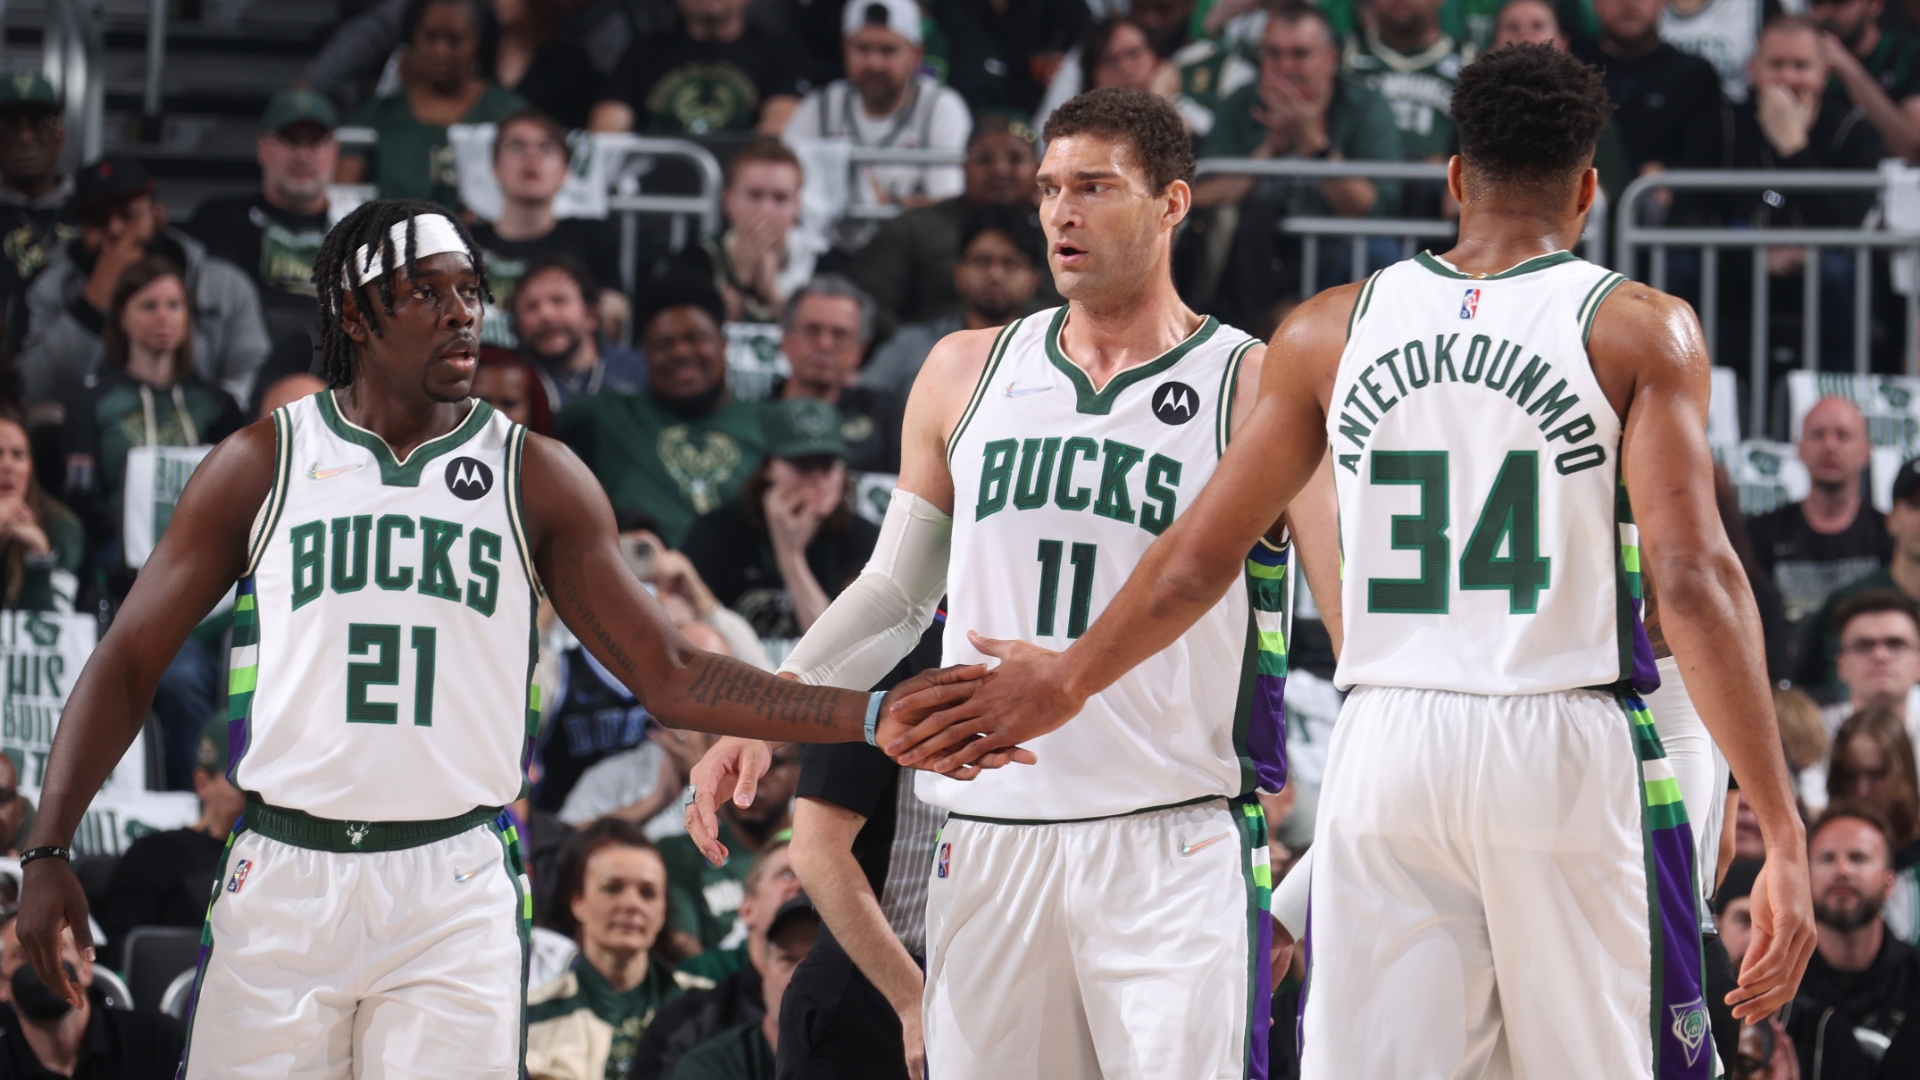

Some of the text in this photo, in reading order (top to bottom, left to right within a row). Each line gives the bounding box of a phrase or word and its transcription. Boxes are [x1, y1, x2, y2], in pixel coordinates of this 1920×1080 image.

[1338, 333, 1606, 476] ANTETOKOUNMPO
[975, 436, 1183, 537] BUCKS
[1367, 450, 1551, 614] 34
[290, 514, 502, 618] BUCKS
[1036, 539, 1097, 638] 11
[346, 623, 436, 727] 21
